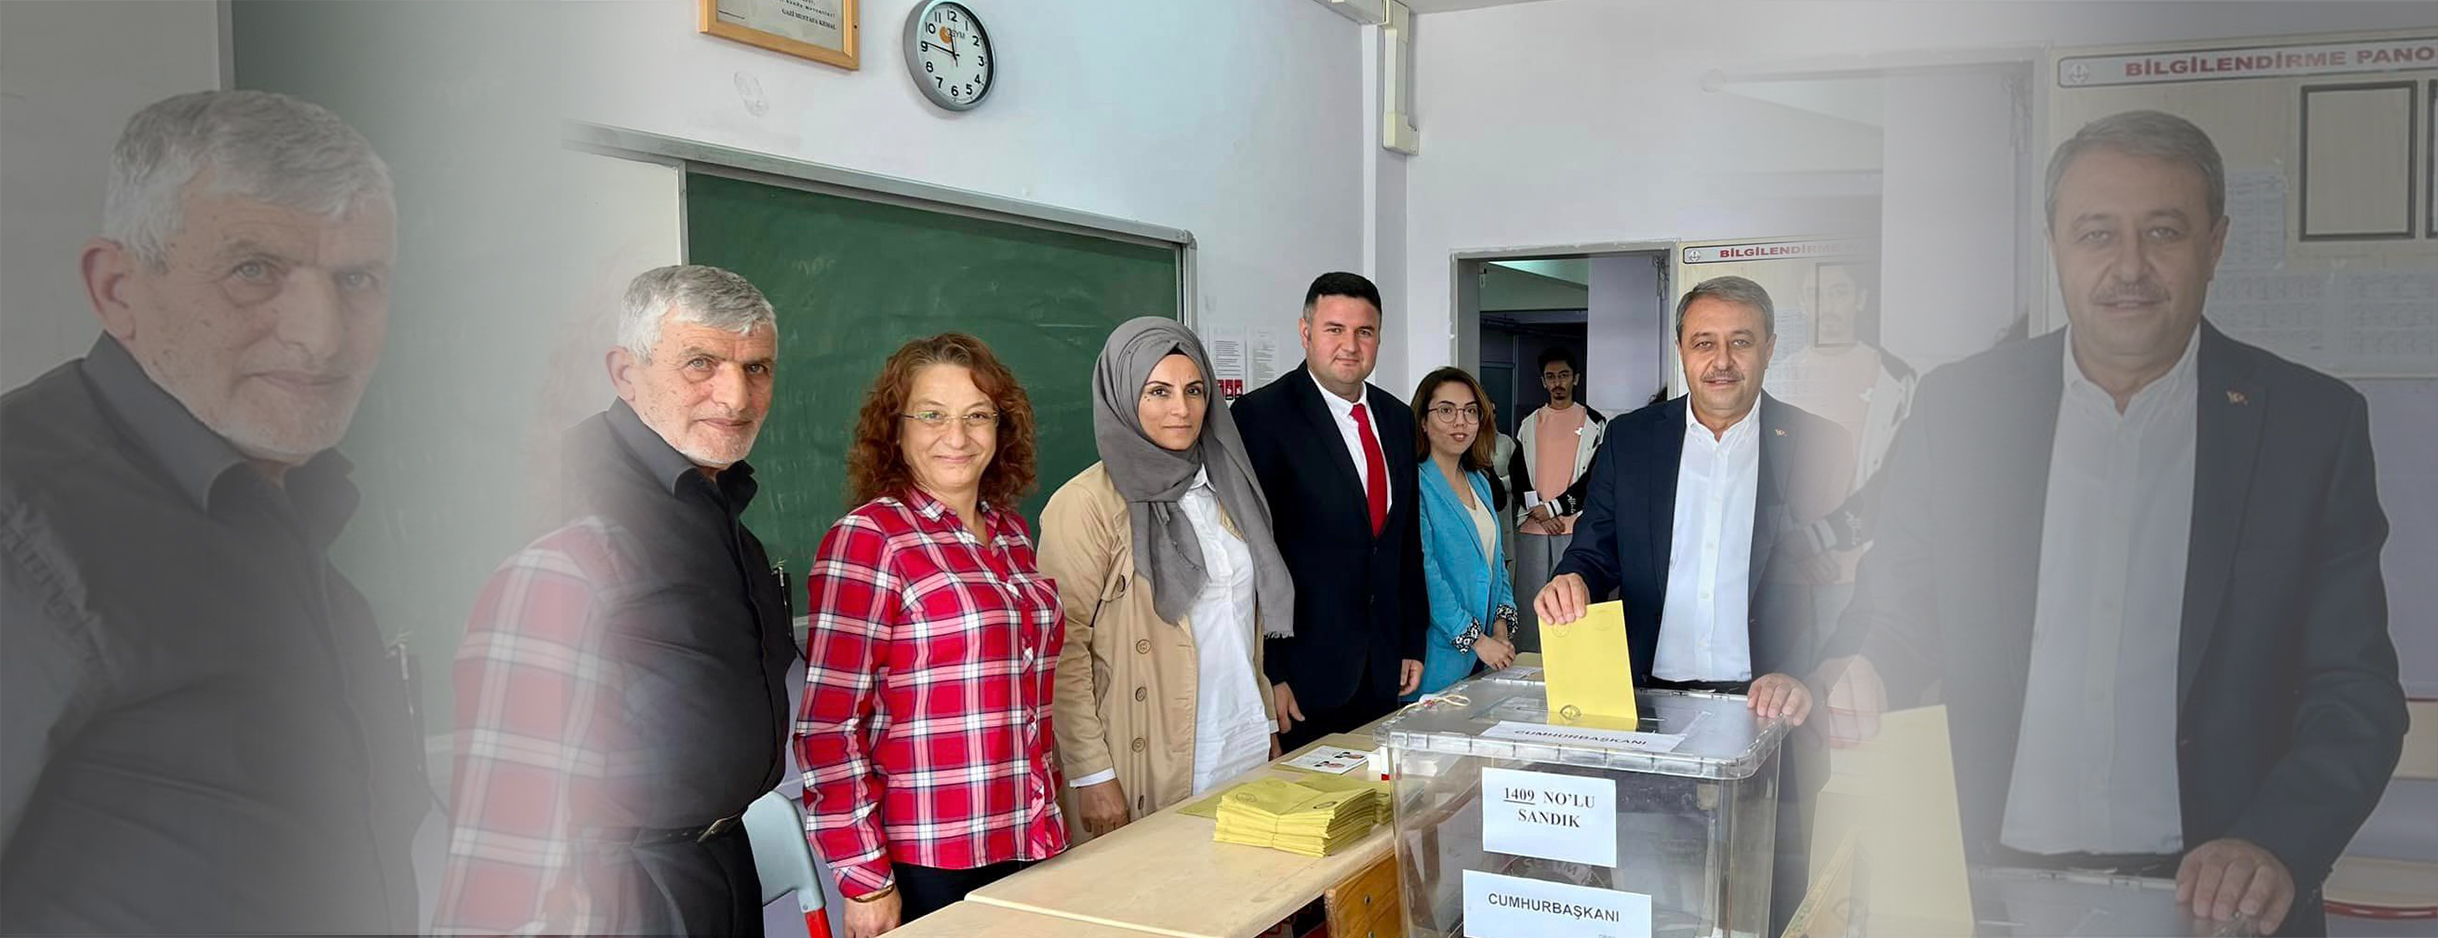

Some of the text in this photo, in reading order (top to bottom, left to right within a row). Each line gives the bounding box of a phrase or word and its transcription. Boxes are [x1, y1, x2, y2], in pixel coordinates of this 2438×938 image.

[935, 11, 941, 23] 11
[947, 9, 957, 22] 12
[925, 22, 936, 34] 10
[921, 40, 929, 52] 9
[972, 35, 980, 47] 2
[926, 61, 934, 73] 8
[978, 56, 985, 67] 3
[2125, 51, 2347, 78] BİLGİLENDİRME
[935, 76, 943, 88] 7
[974, 74, 981, 84] 4
[951, 85, 959, 96] 6
[966, 84, 973, 95] 5
[1720, 244, 1841, 259] BİLGİLENDİRME
[1502, 787, 1535, 801] 1409
[1518, 808, 1581, 828] SANDIK
[1488, 893, 1620, 923] CUMHURBAŞKANI
